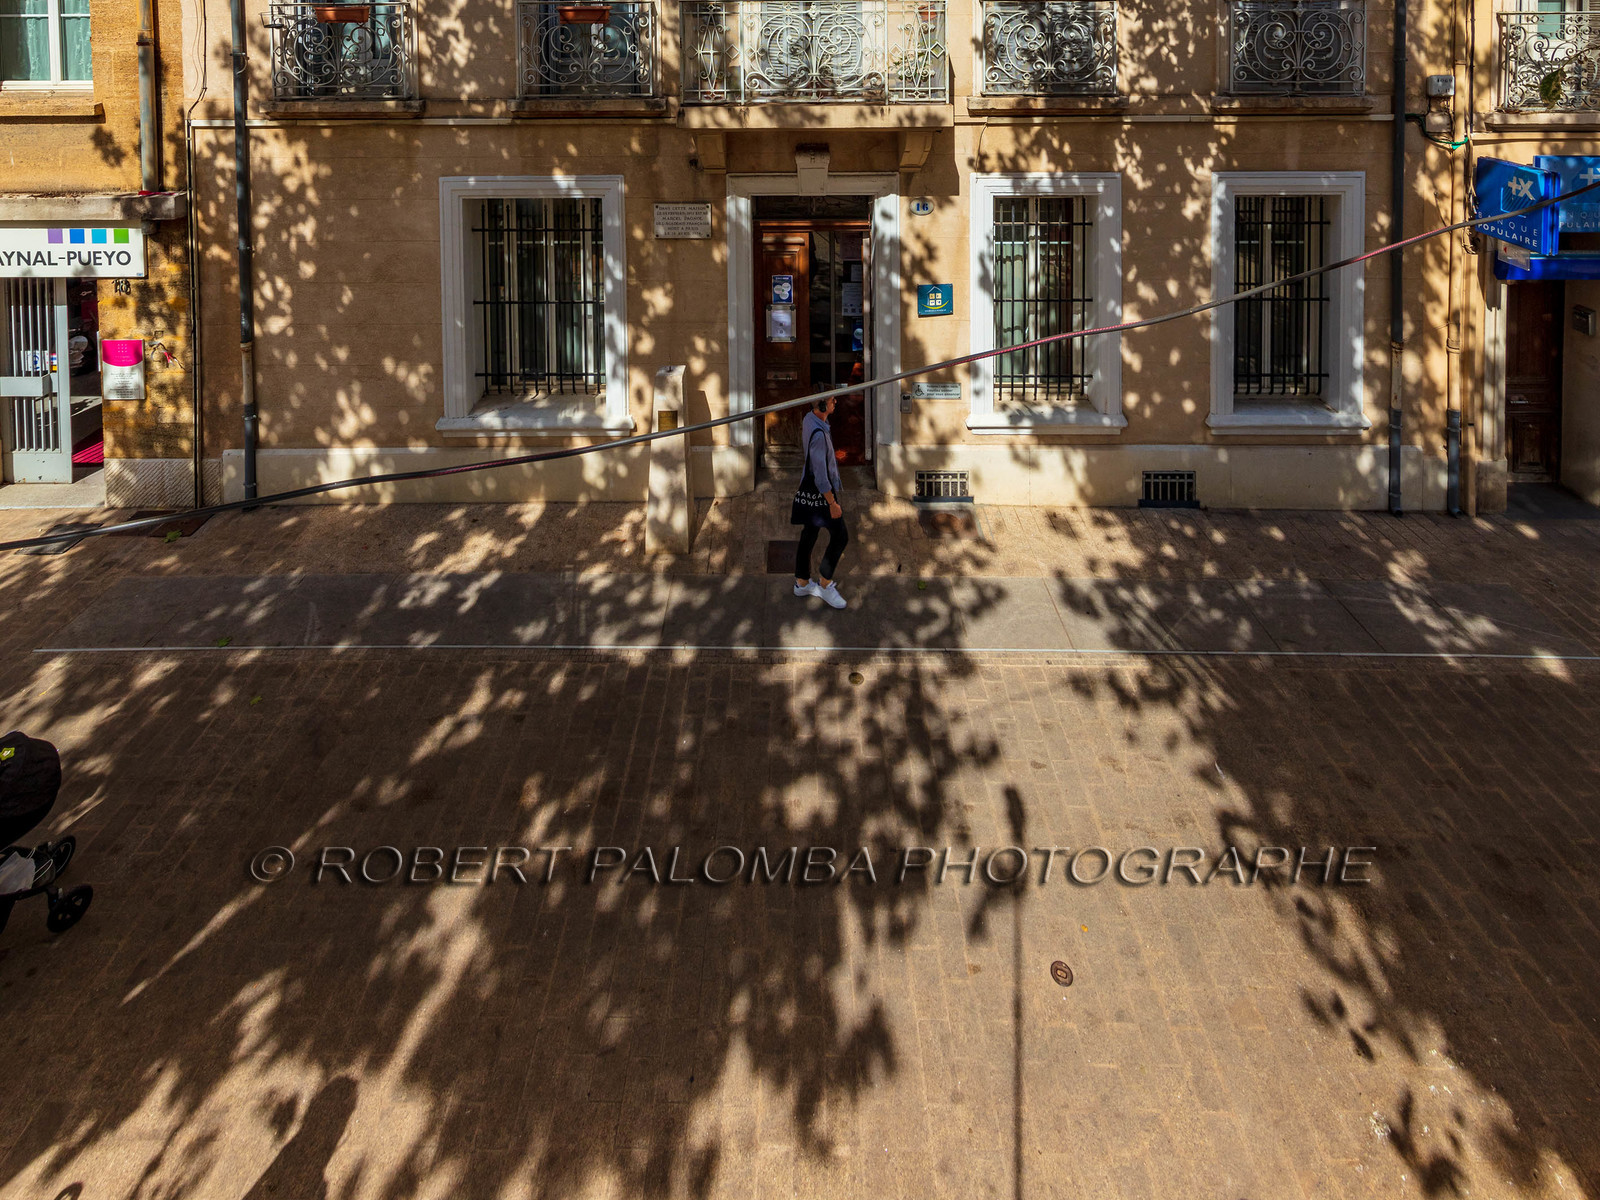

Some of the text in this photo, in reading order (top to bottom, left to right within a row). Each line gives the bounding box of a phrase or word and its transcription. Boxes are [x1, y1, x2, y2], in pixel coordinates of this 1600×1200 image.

[916, 203, 929, 211] 16
[1478, 211, 1538, 236] BNQUE
[0, 251, 131, 266] YNAL-PUEYO
[795, 497, 827, 507] HOWELL
